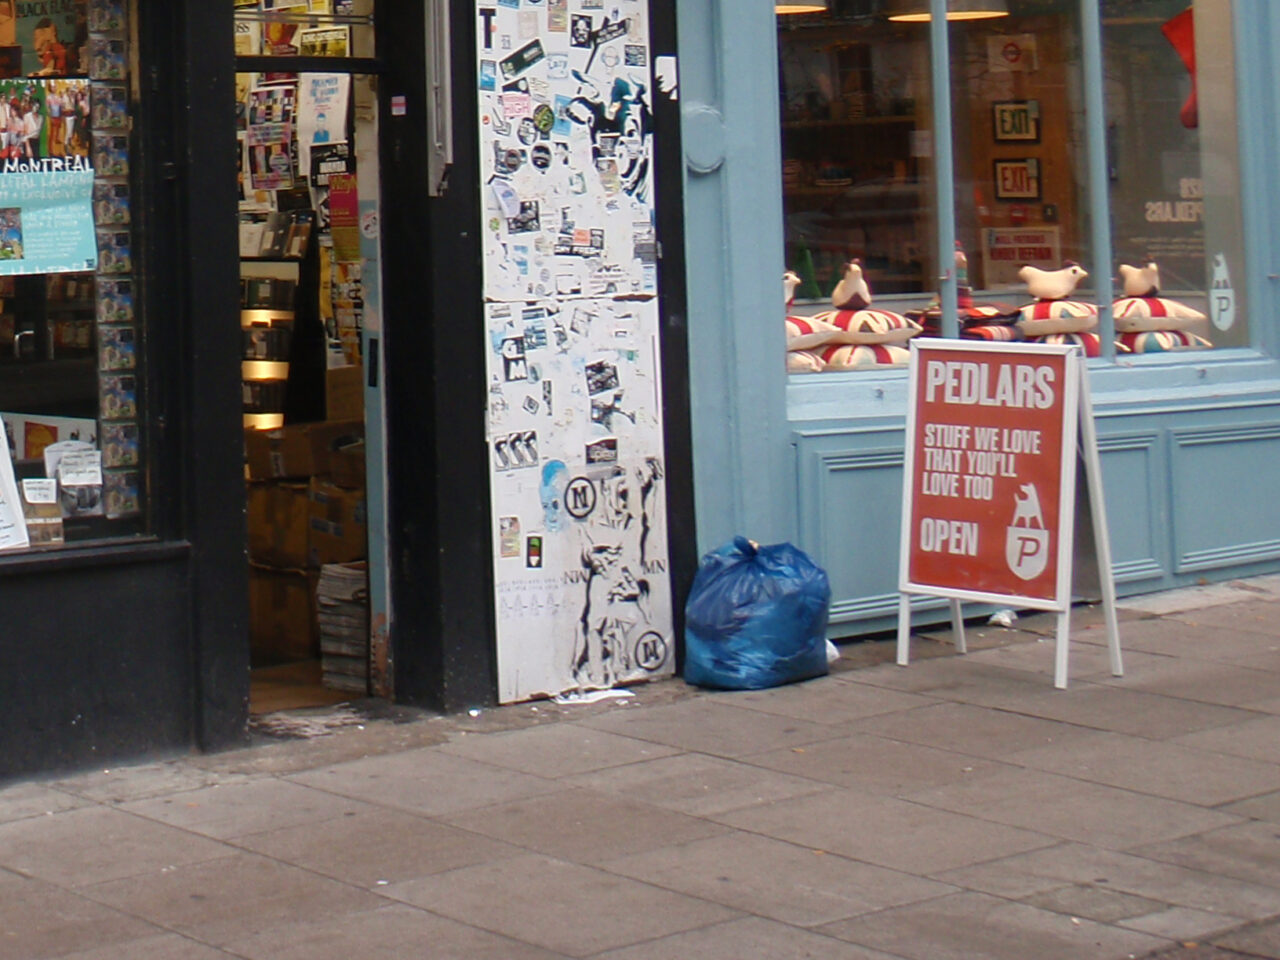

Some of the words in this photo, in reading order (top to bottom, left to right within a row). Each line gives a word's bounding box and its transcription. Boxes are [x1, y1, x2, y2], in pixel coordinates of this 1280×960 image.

[1001, 166, 1031, 193] EXIT
[925, 360, 1056, 410] PEDLARS
[924, 423, 971, 447] STUFF
[974, 426, 999, 451] WE
[1002, 428, 1041, 455] LOVE
[924, 447, 962, 473] THAT
[967, 450, 1017, 477] YOU'LL
[923, 472, 959, 497] LOVE
[963, 475, 993, 501] TOO
[921, 517, 978, 557] OPEN
